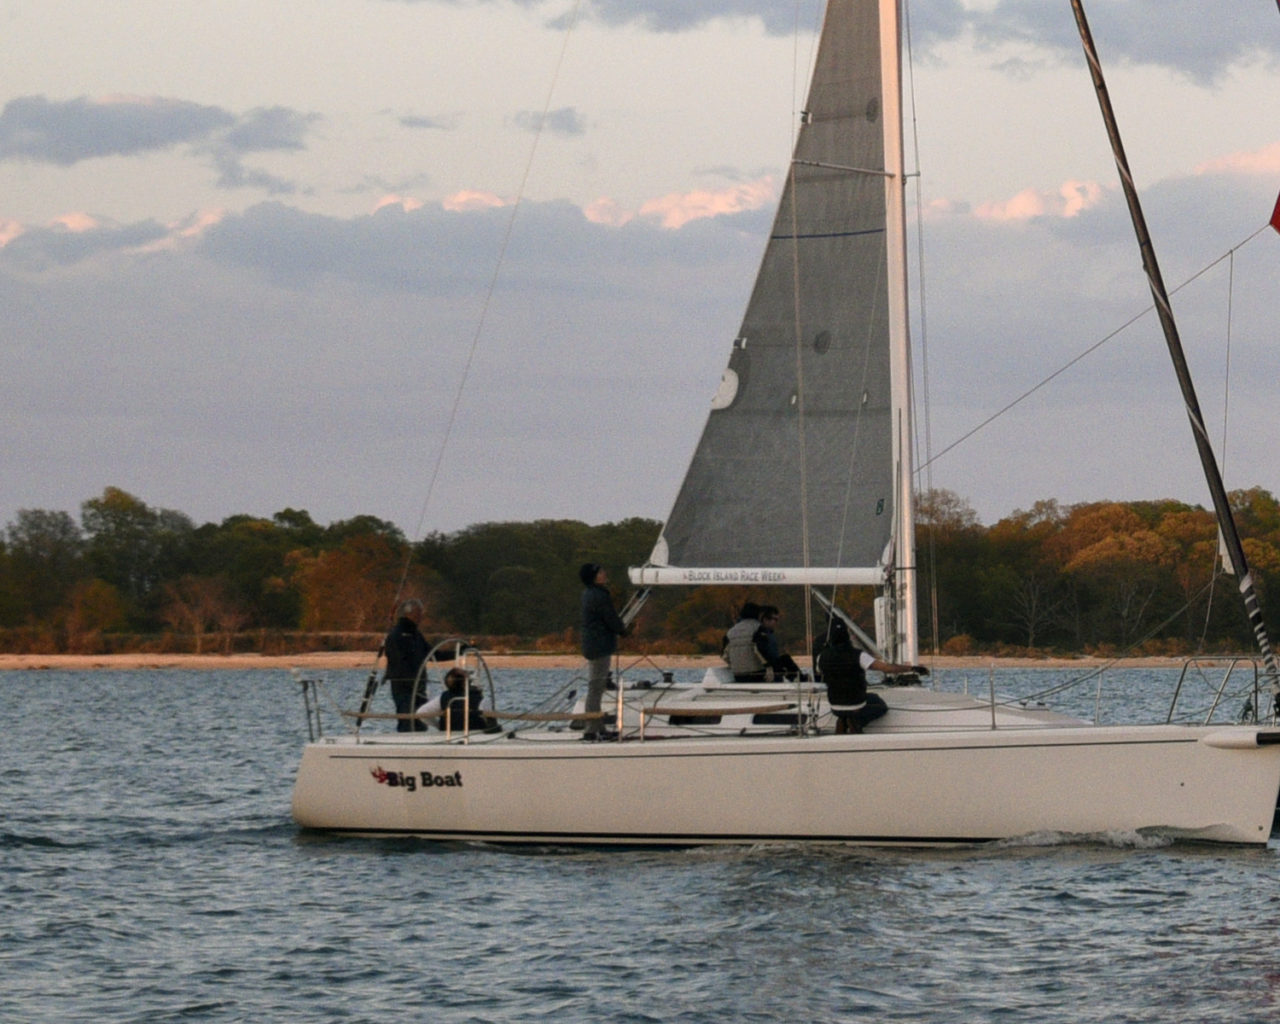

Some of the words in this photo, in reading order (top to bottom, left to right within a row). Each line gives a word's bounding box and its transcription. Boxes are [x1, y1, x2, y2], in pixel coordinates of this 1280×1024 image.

[740, 570, 759, 582] RACE
[761, 570, 783, 582] WEEK
[386, 771, 417, 792] Big
[420, 770, 463, 788] Boat
